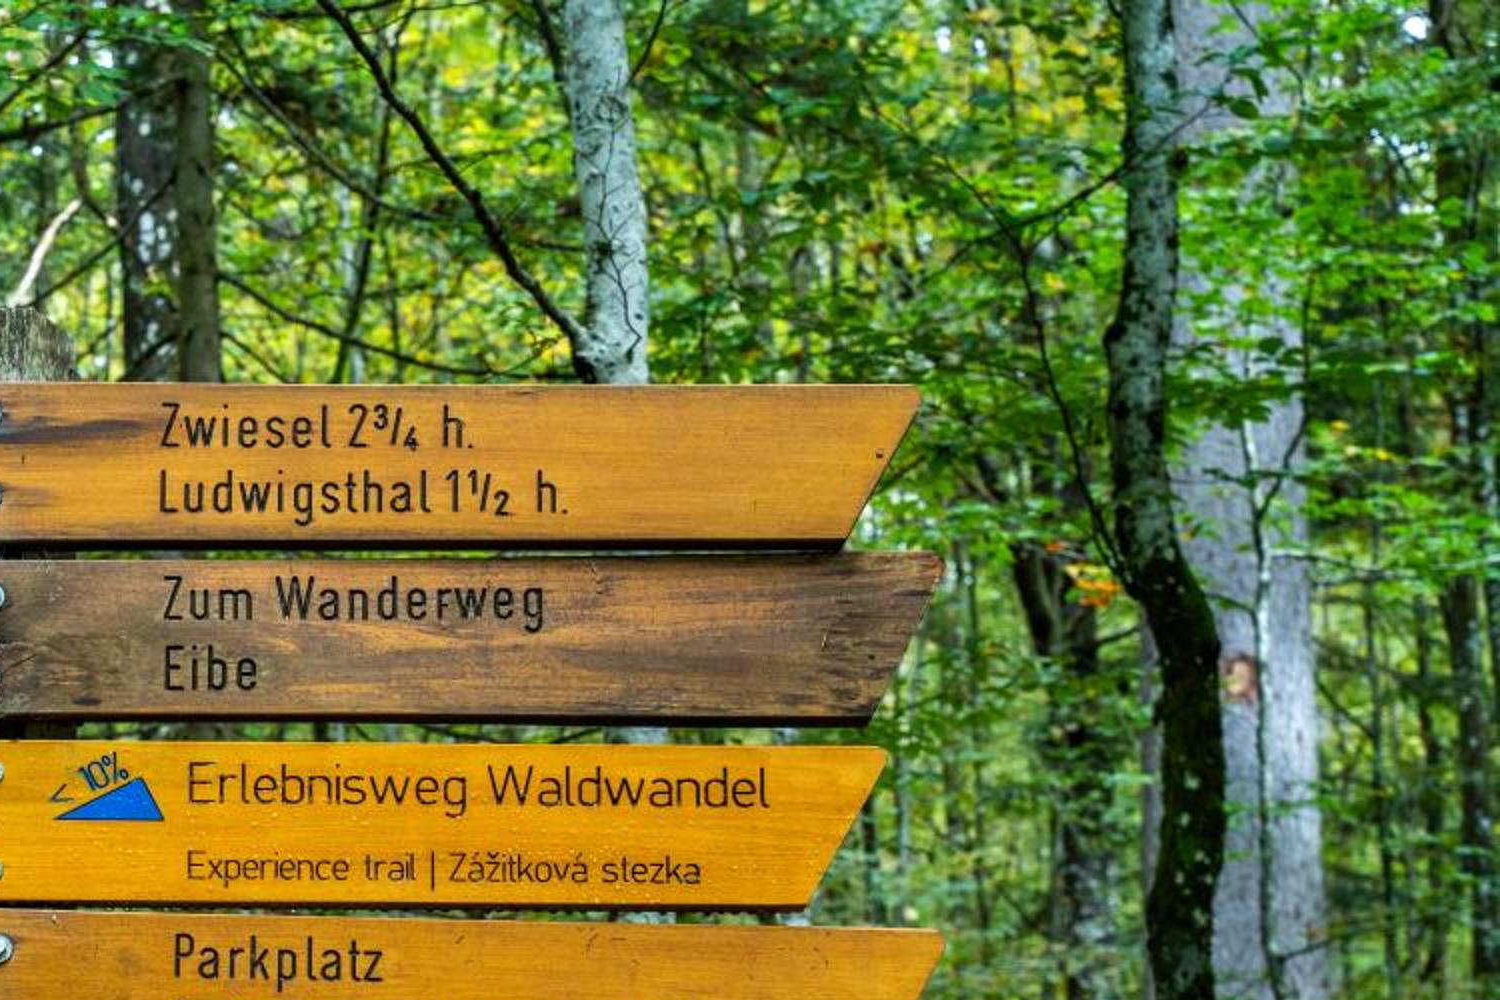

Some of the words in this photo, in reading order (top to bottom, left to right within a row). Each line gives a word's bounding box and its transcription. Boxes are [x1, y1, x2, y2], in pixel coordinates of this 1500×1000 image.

[160, 402, 332, 449] Zwiesel
[441, 403, 474, 449] h.
[159, 468, 432, 527] Ludwigsthal
[535, 468, 569, 515] h.
[163, 575, 253, 621] Zum
[275, 575, 545, 633] Wanderweg
[163, 645, 258, 692] Eibe
[78, 752, 132, 792] 10%
[187, 761, 468, 819] Erlebnisweg
[486, 764, 771, 809] Waldwandel
[186, 850, 351, 889] Experience
[364, 852, 417, 882] trail
[448, 851, 590, 885] Zážitková
[601, 854, 702, 886] stezka
[173, 932, 384, 992] Parkplatz
